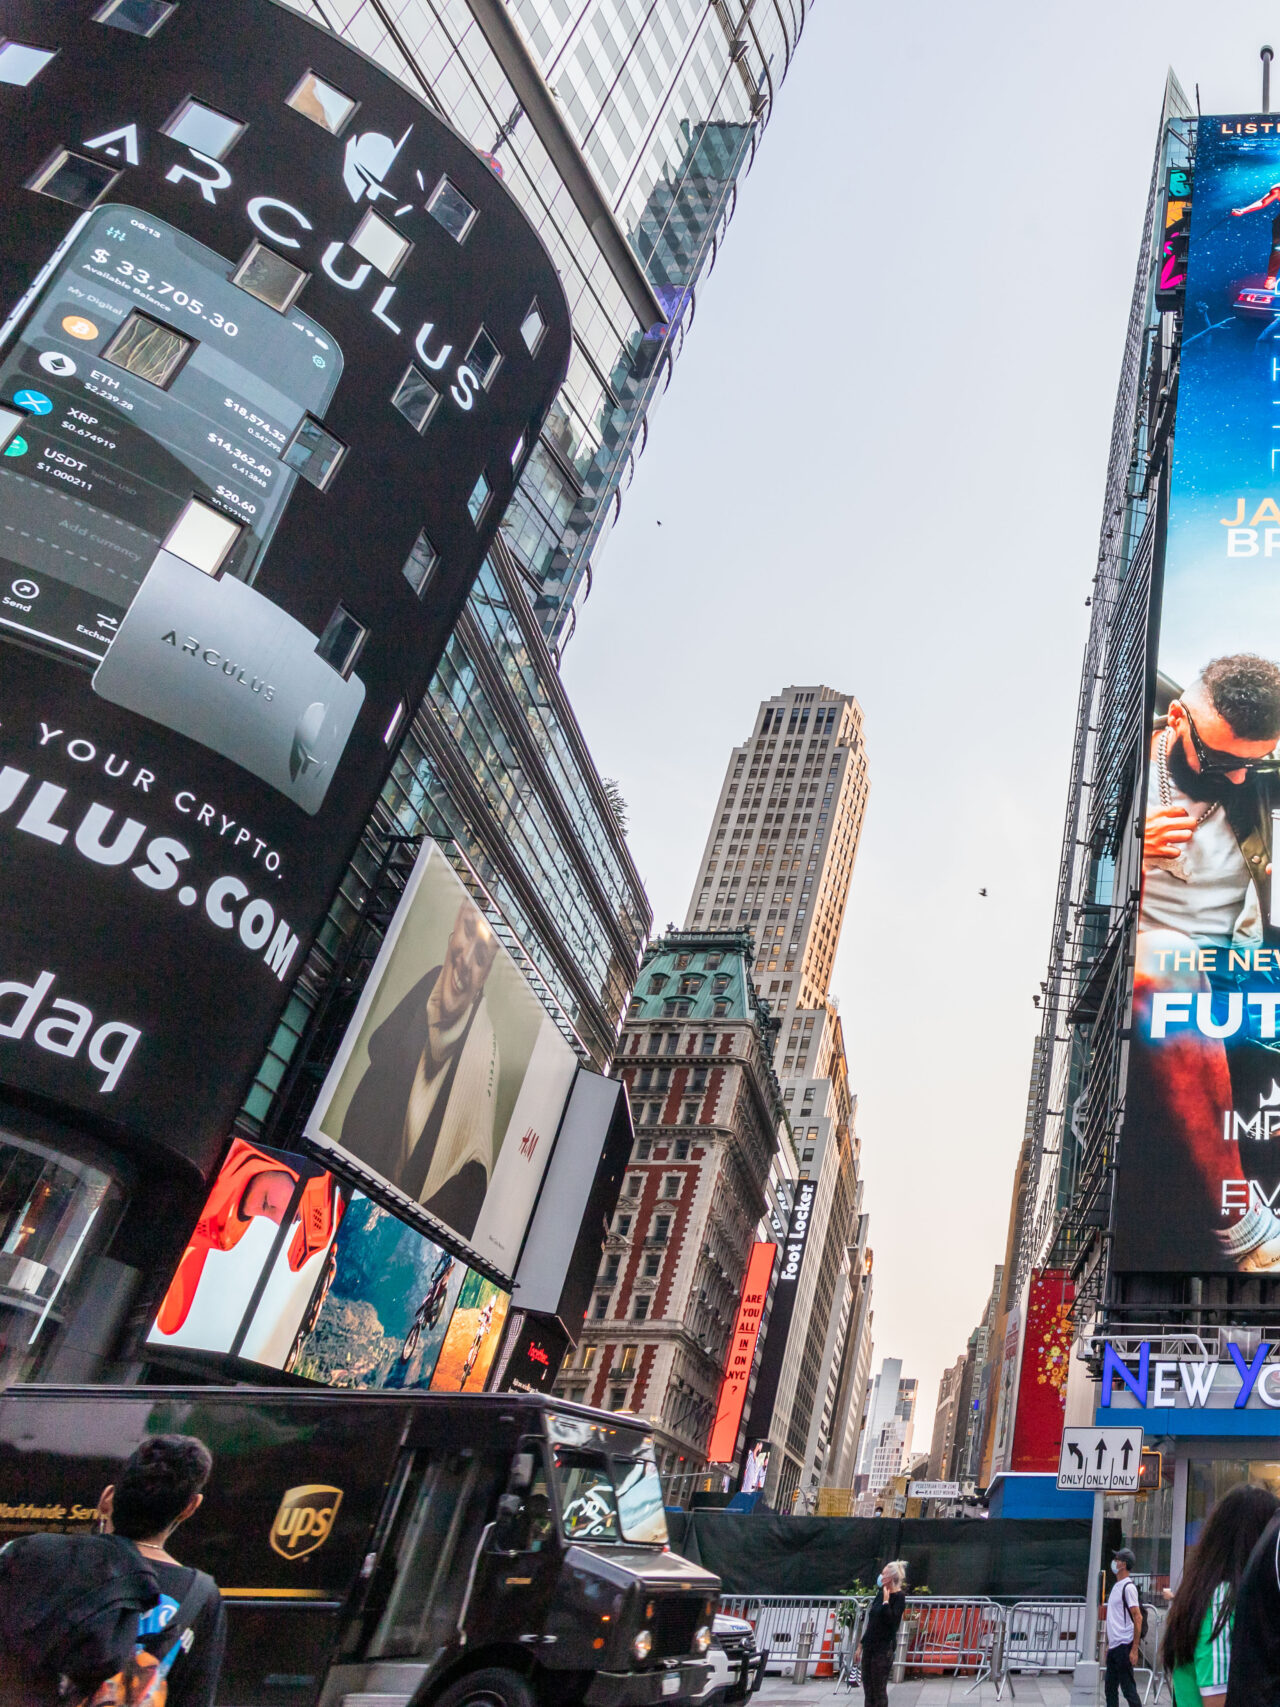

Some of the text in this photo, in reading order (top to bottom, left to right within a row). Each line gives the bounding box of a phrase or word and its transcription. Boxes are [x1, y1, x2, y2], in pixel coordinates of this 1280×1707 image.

[130, 218, 161, 239] 09:13
[83, 122, 480, 411] ARCULUS
[67, 285, 123, 316] My Digital
[82, 263, 172, 313] Available Balance
[116, 260, 239, 337] 33,705.30
[90, 369, 120, 389] ETH
[84, 382, 134, 411] $2,239.28
[67, 407, 99, 425] XRP
[223, 397, 287, 444] $18,574.32
[61, 420, 117, 450] $0.674919
[43, 447, 88, 472] USDT
[207, 432, 272, 477] $14,362.40
[36, 461, 93, 491] $1.000211
[215, 484, 257, 514] $20.60
[58, 519, 142, 562] Add currency
[2, 596, 32, 613] Send
[75, 624, 113, 645] Exchan
[161, 627, 277, 703] ARCULUS
[40, 722, 283, 880] YOUR CRYPTO.
[1152, 948, 1217, 972] THE
[788, 1184, 815, 1239] Locker.
[780, 1243, 803, 1281] Foot
[744, 1294, 763, 1304] ARE
[743, 1308, 761, 1318] YOU
[738, 1322, 756, 1332] ALL
[739, 1339, 749, 1348] IN
[734, 1355, 747, 1365] ON
[728, 1371, 747, 1381] NYC
[1100, 1340, 1219, 1409] NEW
[731, 1385, 738, 1395] ?
[1060, 1474, 1084, 1485] ONLY
[1086, 1475, 1110, 1486] ONLY
[1112, 1475, 1136, 1486] ONLY
[67, 1504, 101, 1520] Serv
[277, 1506, 333, 1549] ups
